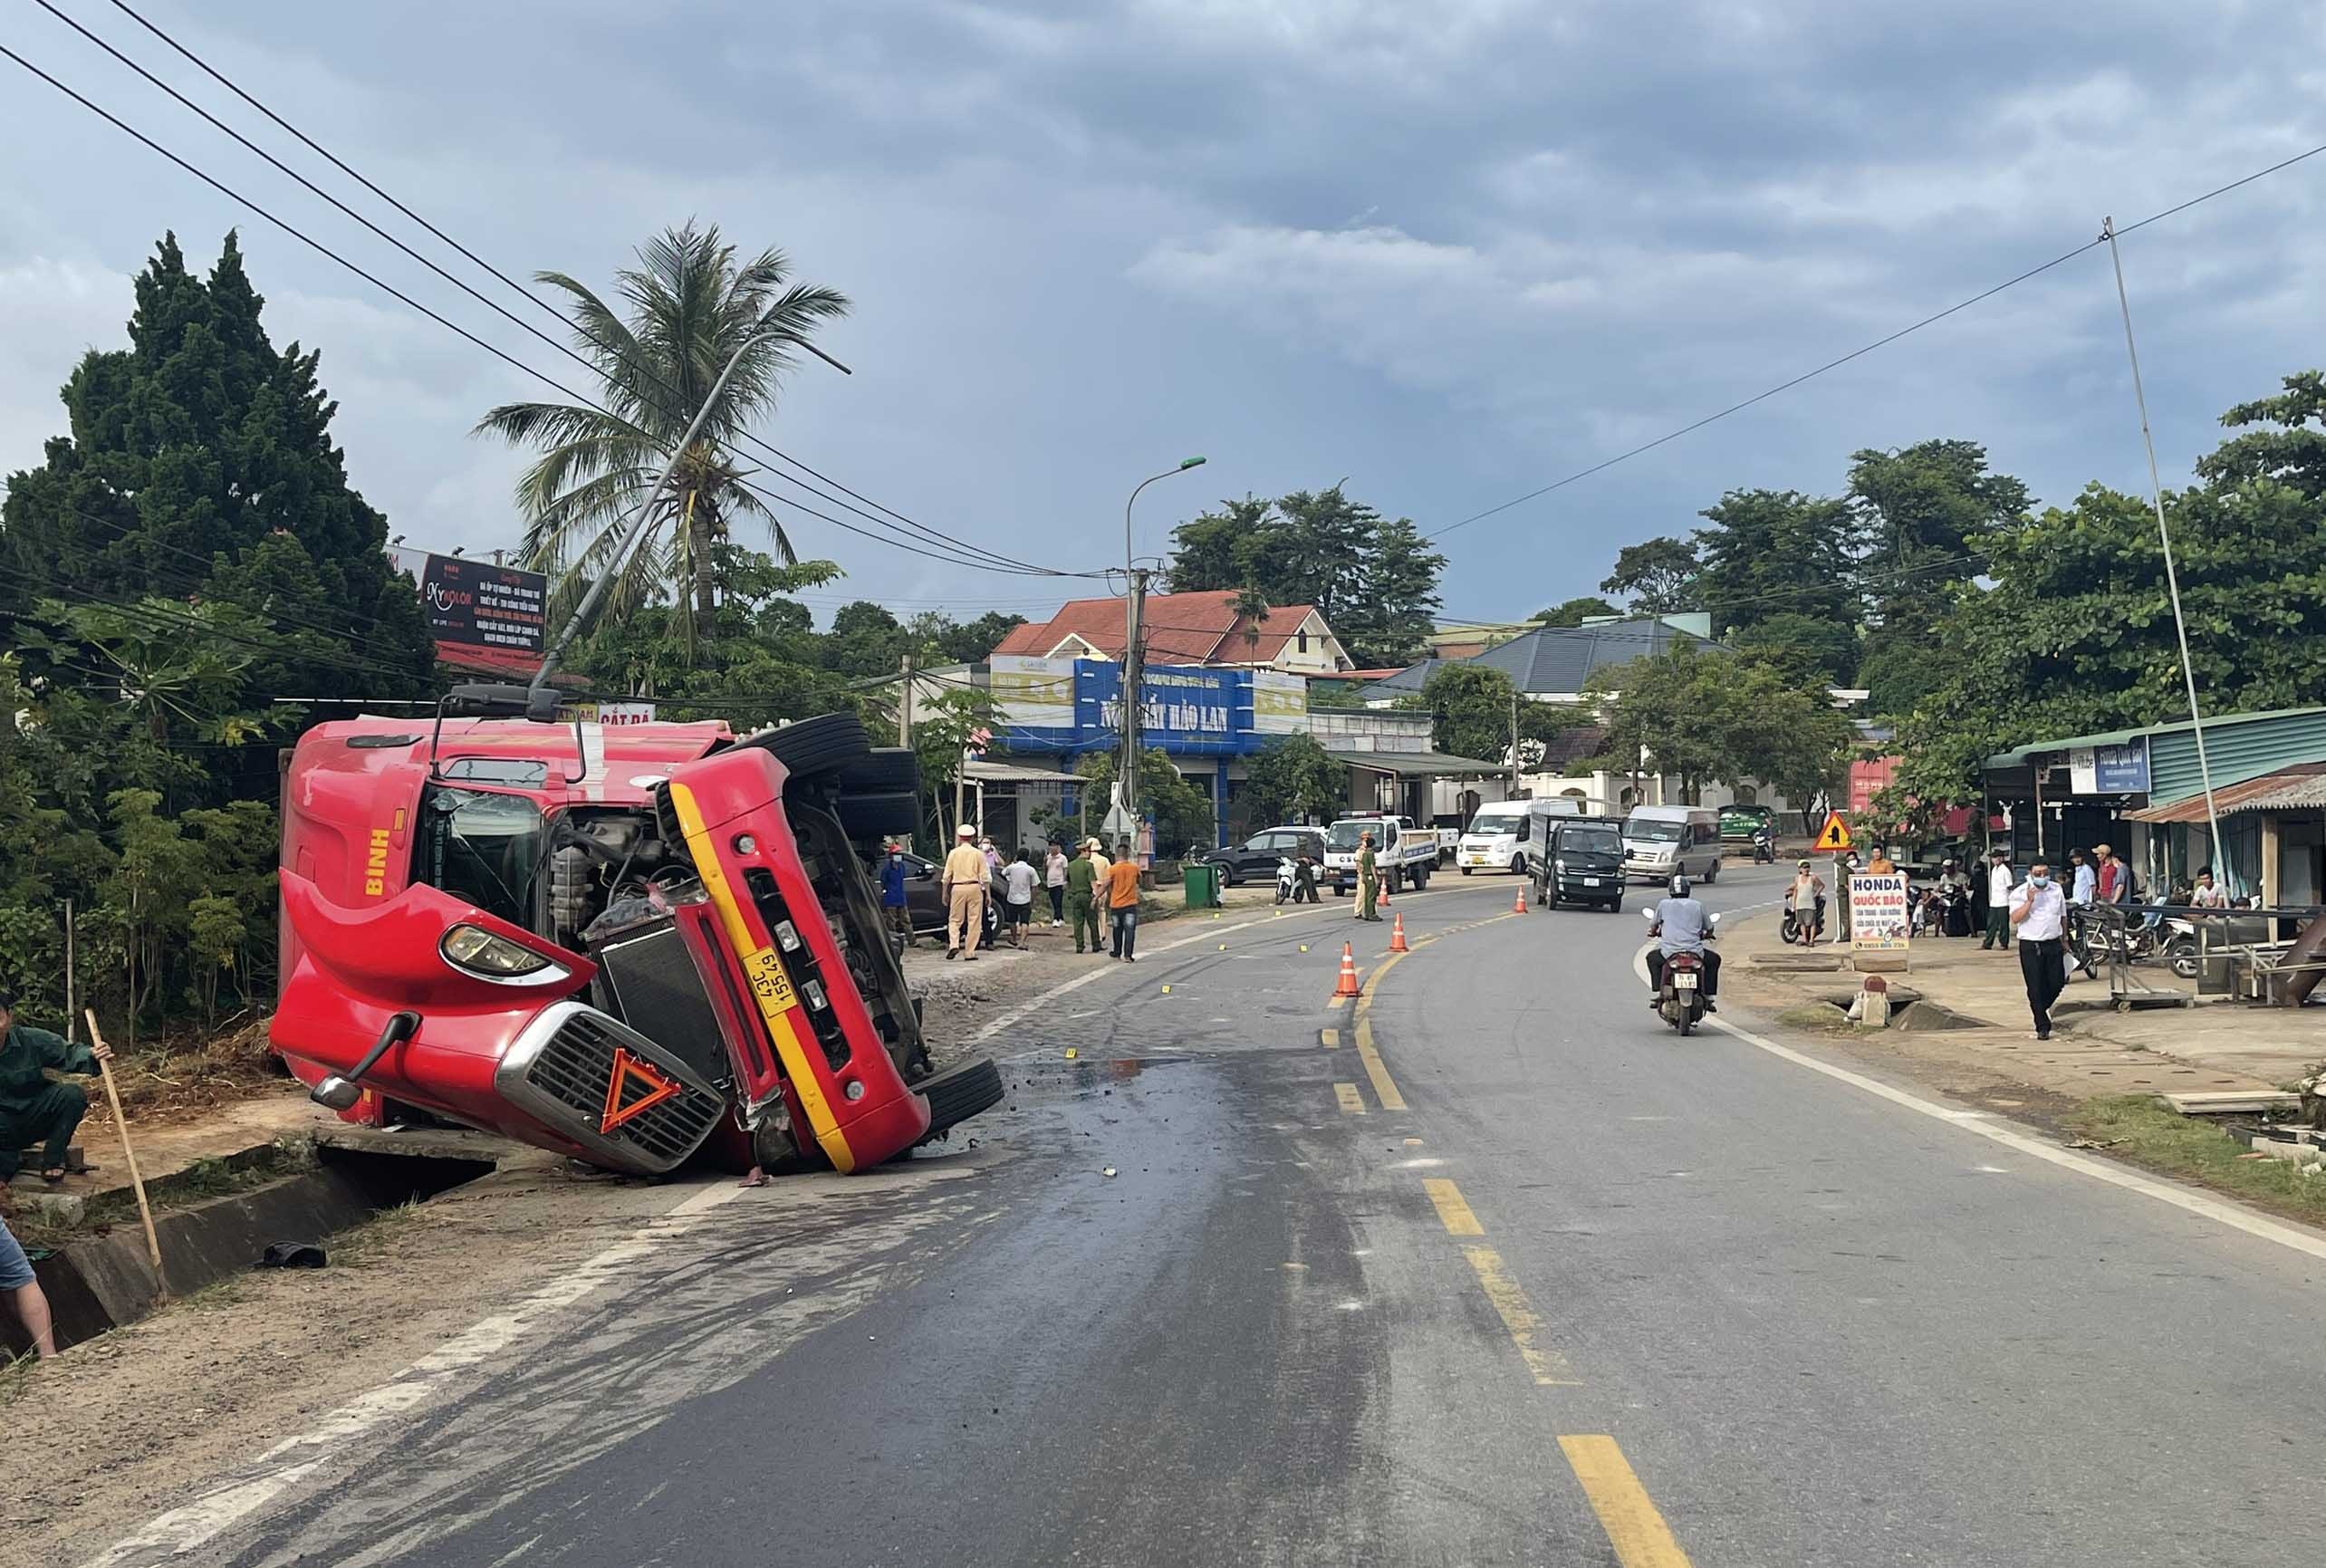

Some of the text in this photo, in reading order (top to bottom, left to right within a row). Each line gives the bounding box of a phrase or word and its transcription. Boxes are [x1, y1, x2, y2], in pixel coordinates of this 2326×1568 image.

[1200, 706, 1228, 732] LAN
[1853, 878, 1902, 891] HONDA
[1853, 892, 1880, 906] QUỐC
[753, 971, 772, 996] 43C
[762, 954, 792, 1001] 155.49
